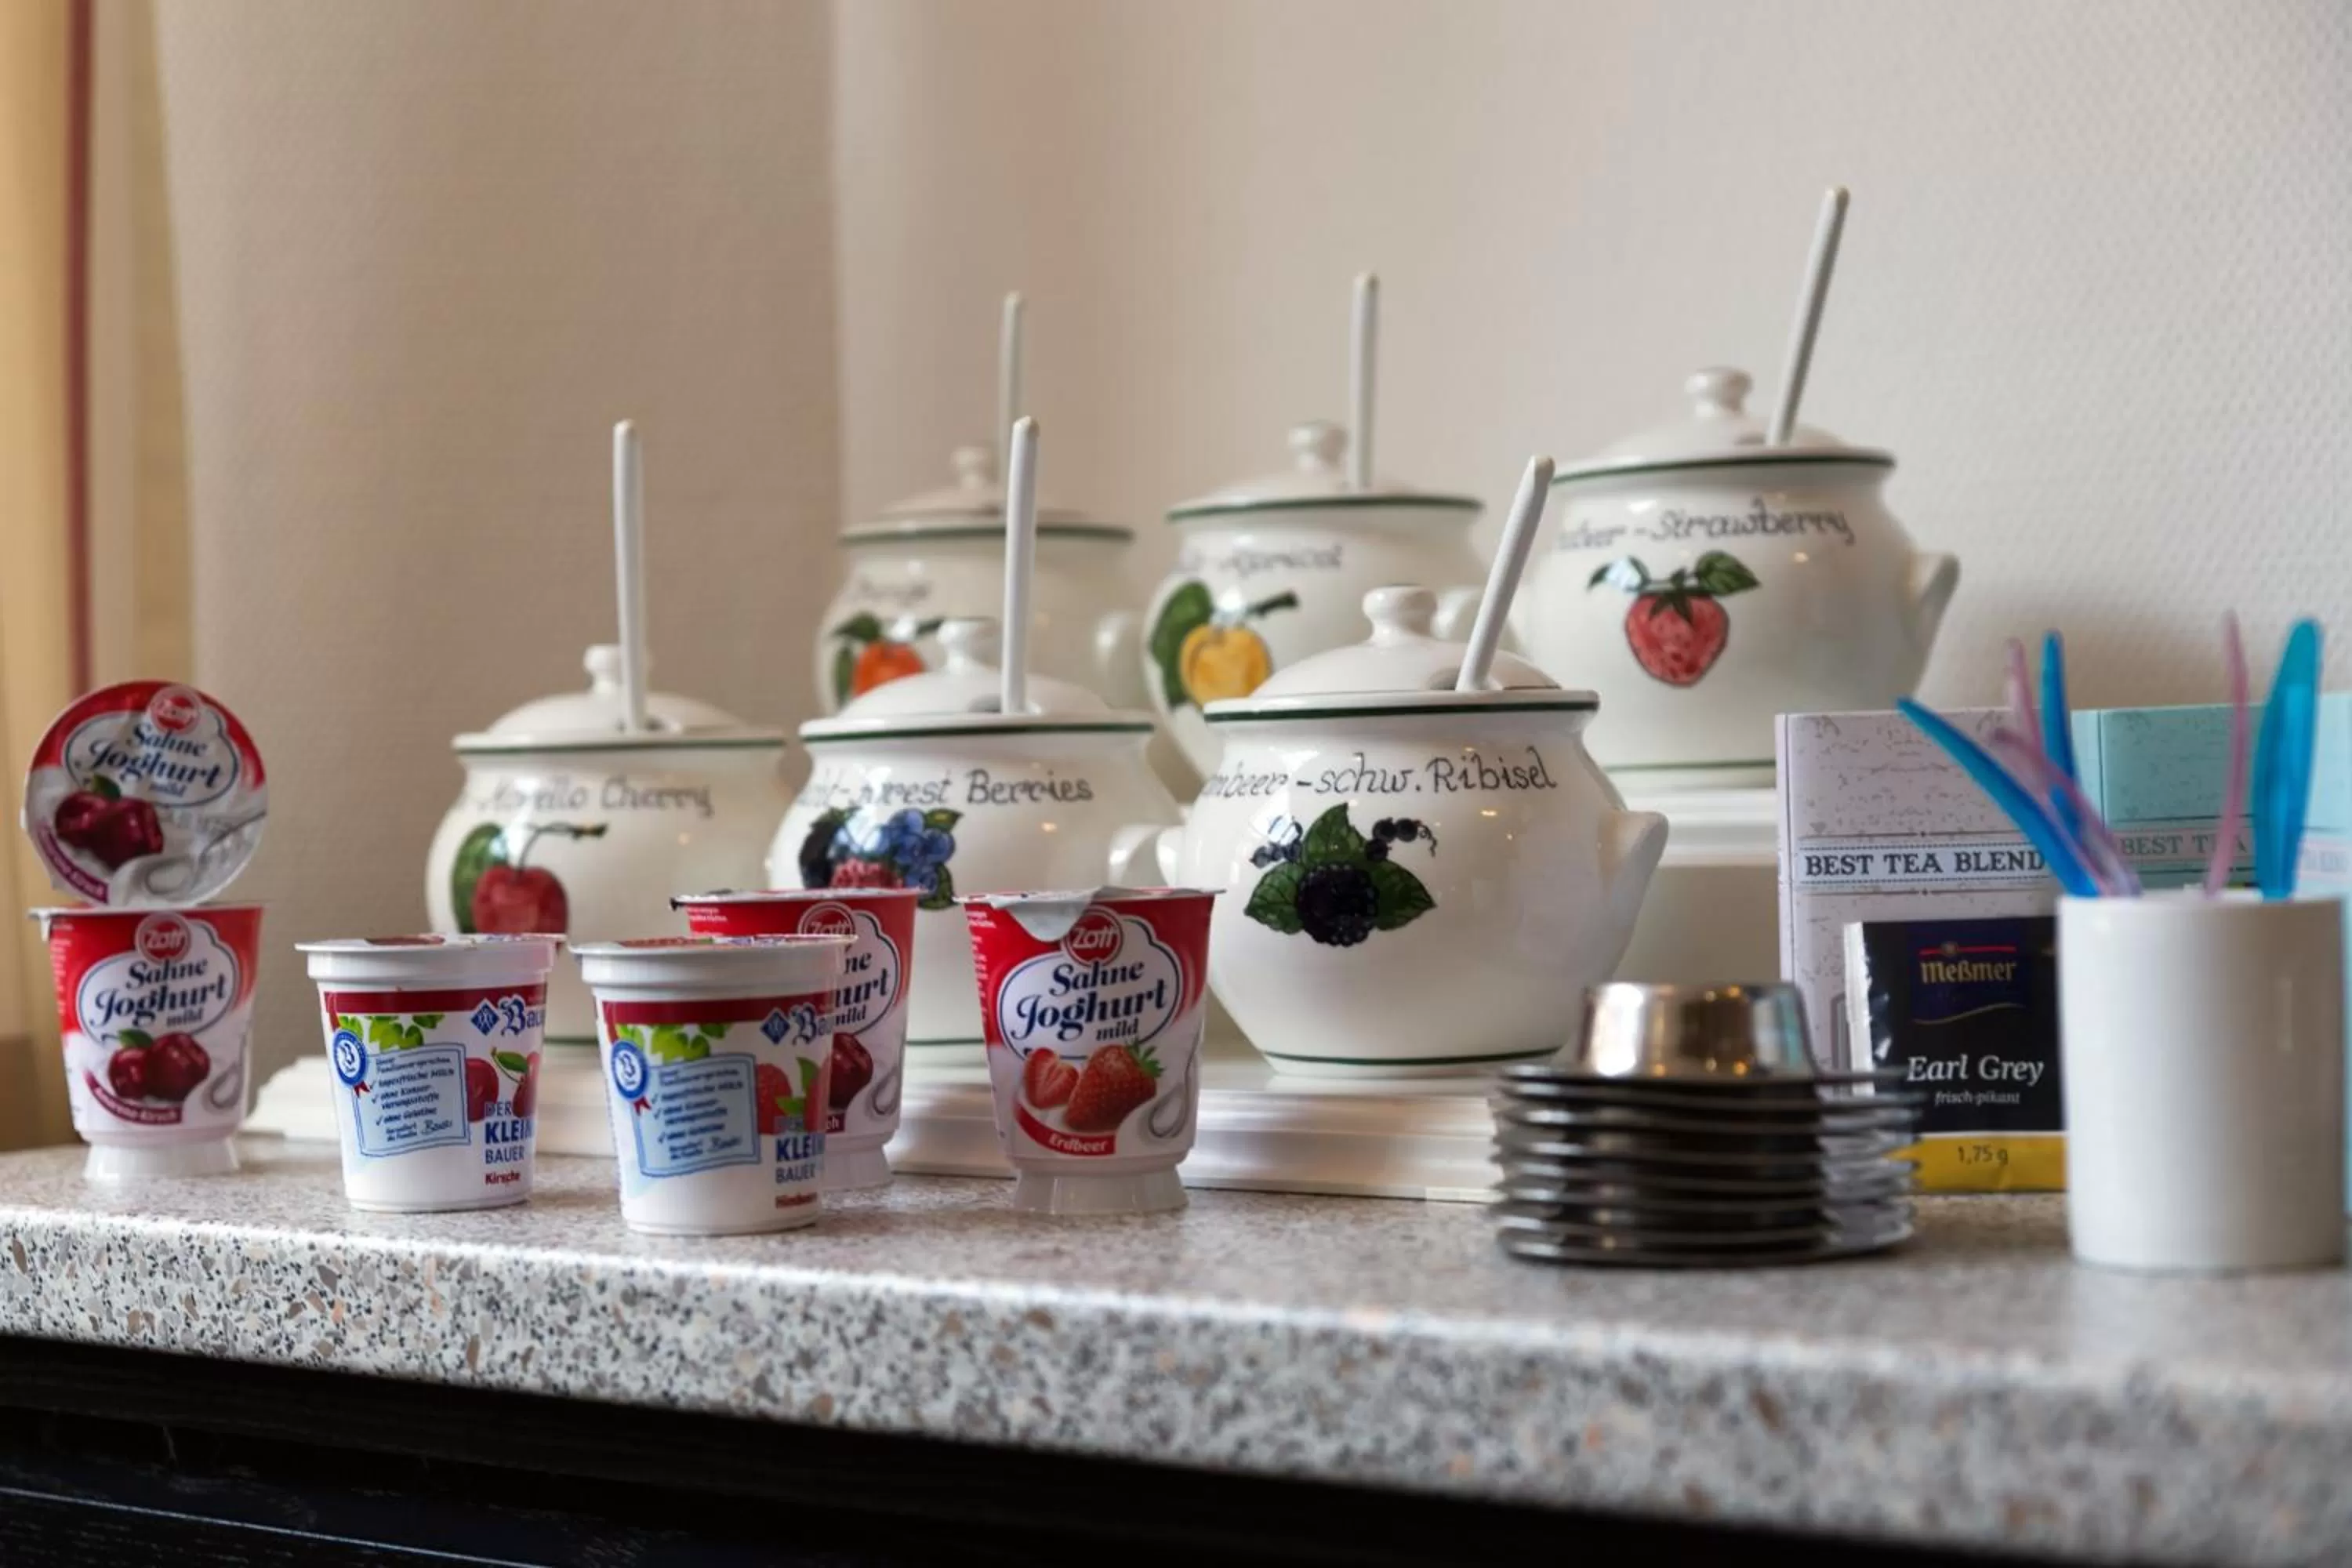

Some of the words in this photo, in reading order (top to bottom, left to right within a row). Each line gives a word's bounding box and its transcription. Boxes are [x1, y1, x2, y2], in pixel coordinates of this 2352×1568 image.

[132, 722, 208, 758] Sahne
[88, 740, 221, 789] Joghurt
[1425, 746, 1558, 794] Ribisel
[600, 775, 714, 817] Cherry
[967, 768, 1093, 806] Berries
[2120, 836, 2183, 856] BEST
[1806, 855, 1873, 876] BEST
[1884, 853, 1944, 874] TEA
[143, 928, 186, 949] Zott
[1072, 924, 1120, 950] Zott
[125, 958, 207, 989] Sahne
[1048, 960, 1145, 997] Sahne
[1920, 960, 2017, 985] Meßmer
[90, 973, 224, 1027] Joghurt
[1011, 978, 1167, 1042] Joghurt
[167, 1007, 204, 1025] mild
[1096, 1018, 1139, 1041] mild
[1907, 1054, 1969, 1081] Earl
[1979, 1054, 2045, 1087] Grey
[485, 1101, 512, 1116] DER
[485, 1146, 524, 1164] BAUER
[1049, 1134, 1109, 1152] Erdbeer
[1997, 1149, 2009, 1166] g
